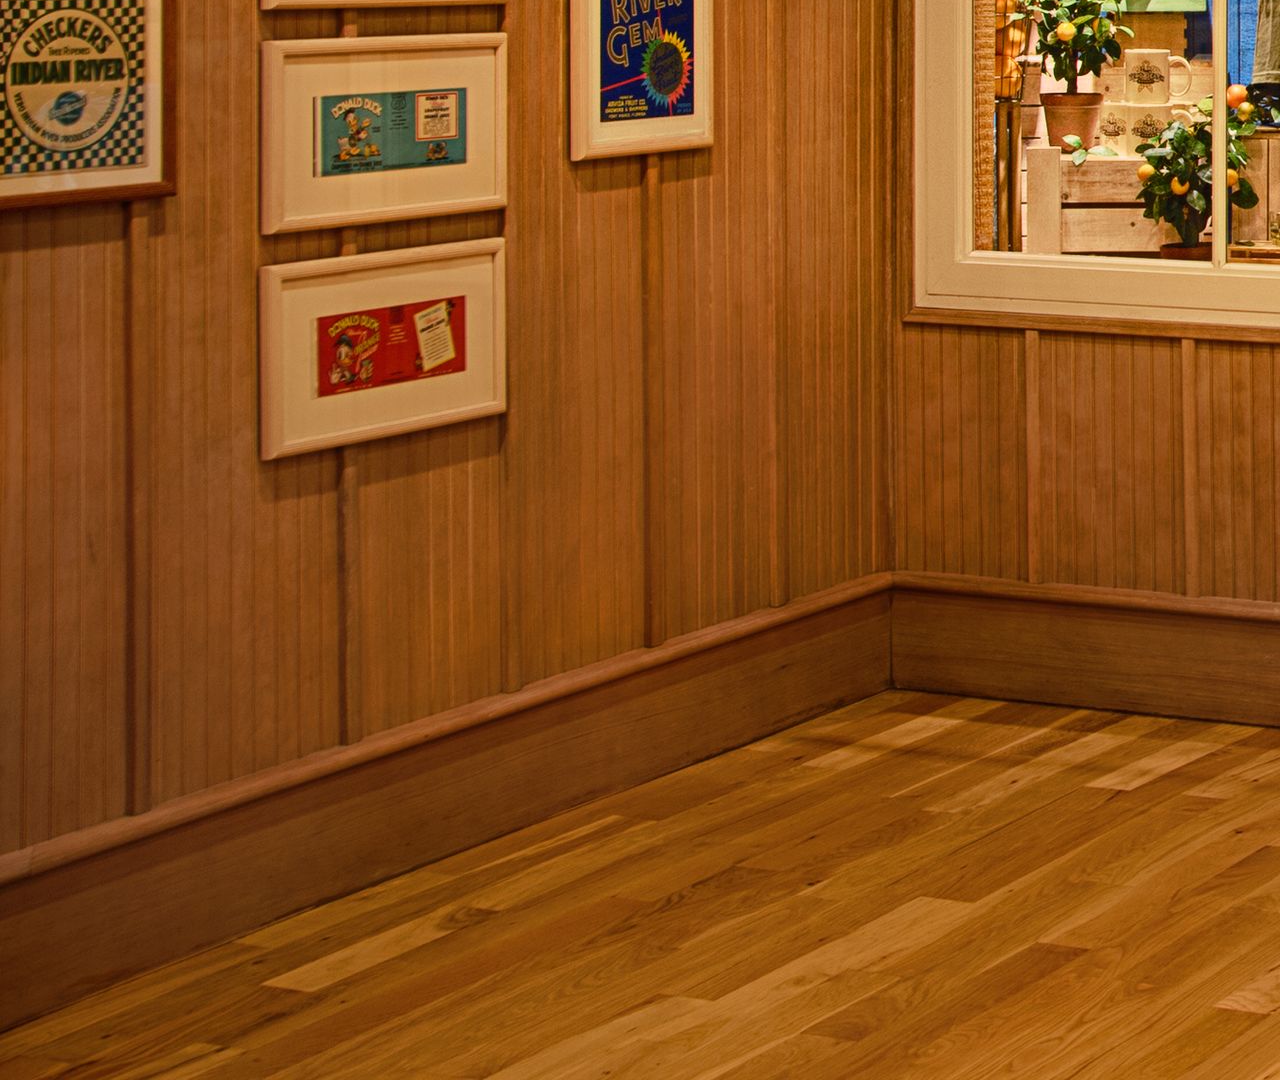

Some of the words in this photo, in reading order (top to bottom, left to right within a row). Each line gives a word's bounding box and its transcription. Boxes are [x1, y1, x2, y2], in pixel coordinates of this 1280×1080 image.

[22, 16, 114, 58] CHECKERS
[606, 17, 663, 67] GEM
[10, 61, 71, 87] INDIAN
[74, 58, 126, 83] RIVER
[331, 97, 363, 119] DONALD
